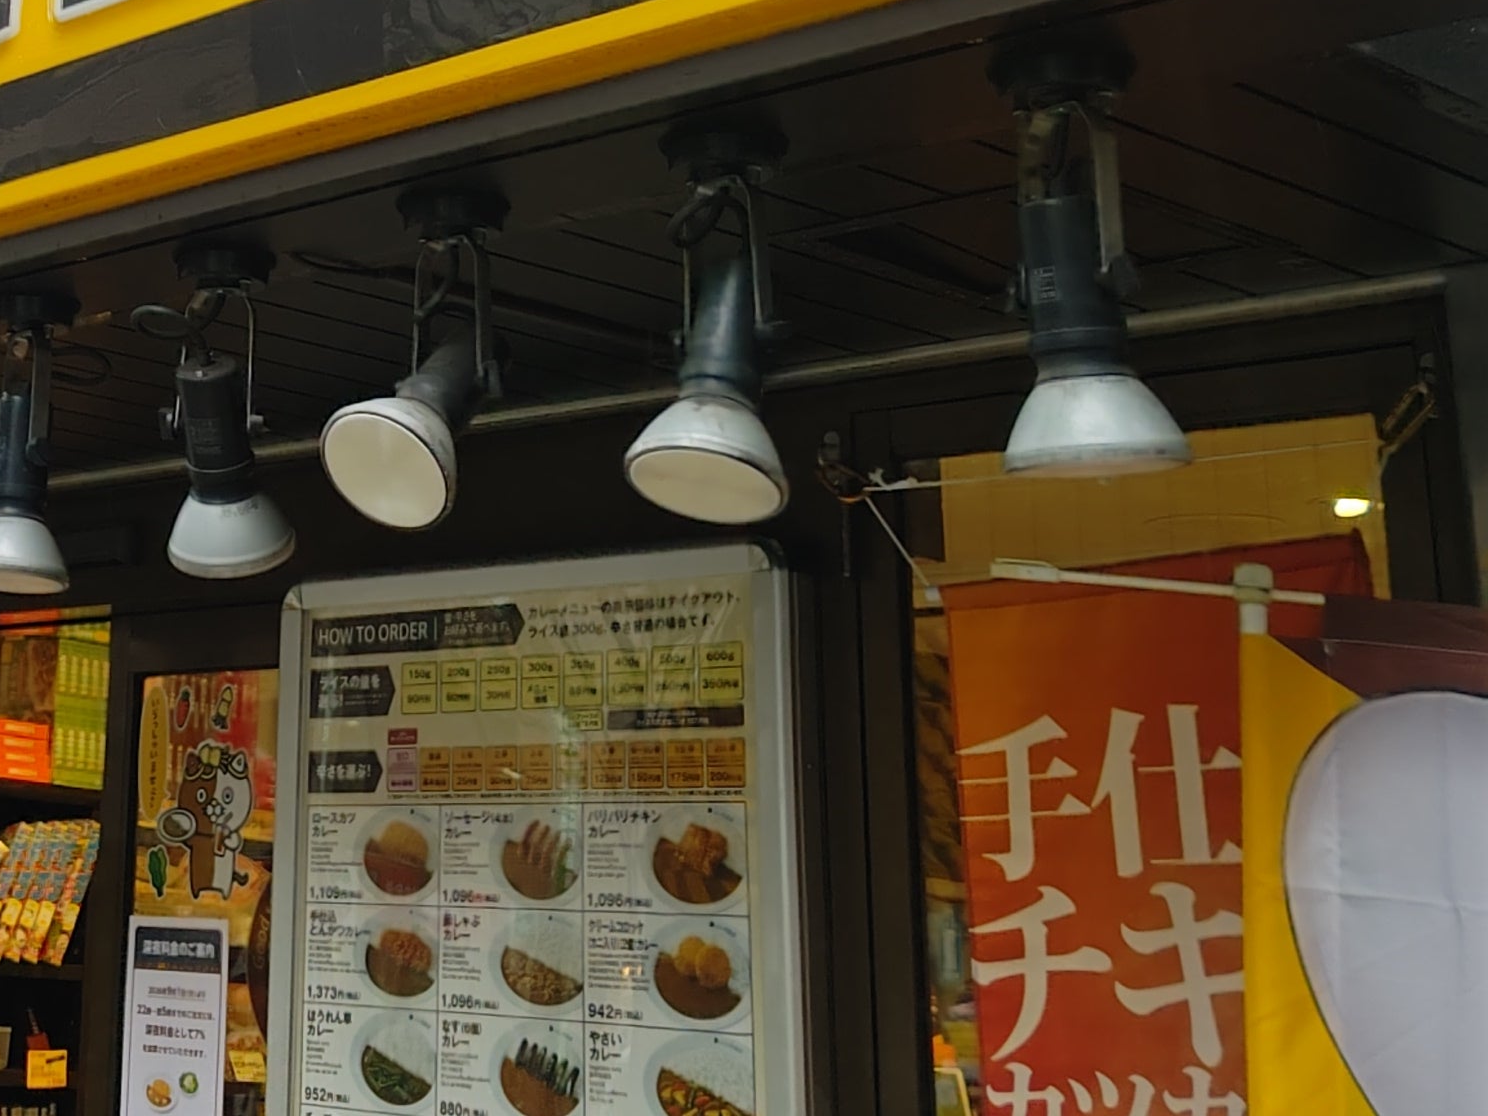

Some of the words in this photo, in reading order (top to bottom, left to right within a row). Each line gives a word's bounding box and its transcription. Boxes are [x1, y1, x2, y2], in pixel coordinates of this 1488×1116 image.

[318, 627, 353, 646] HOW
[356, 625, 375, 642] TO
[378, 620, 428, 642] ORDER
[312, 826, 339, 838] カレー
[444, 827, 472, 839] カレー
[587, 825, 620, 838] カレー
[443, 929, 471, 941] カレー
[307, 1024, 334, 1036] カレー
[442, 1035, 470, 1048] カレー
[588, 1030, 622, 1047] やさい
[588, 1047, 622, 1062] カレー
